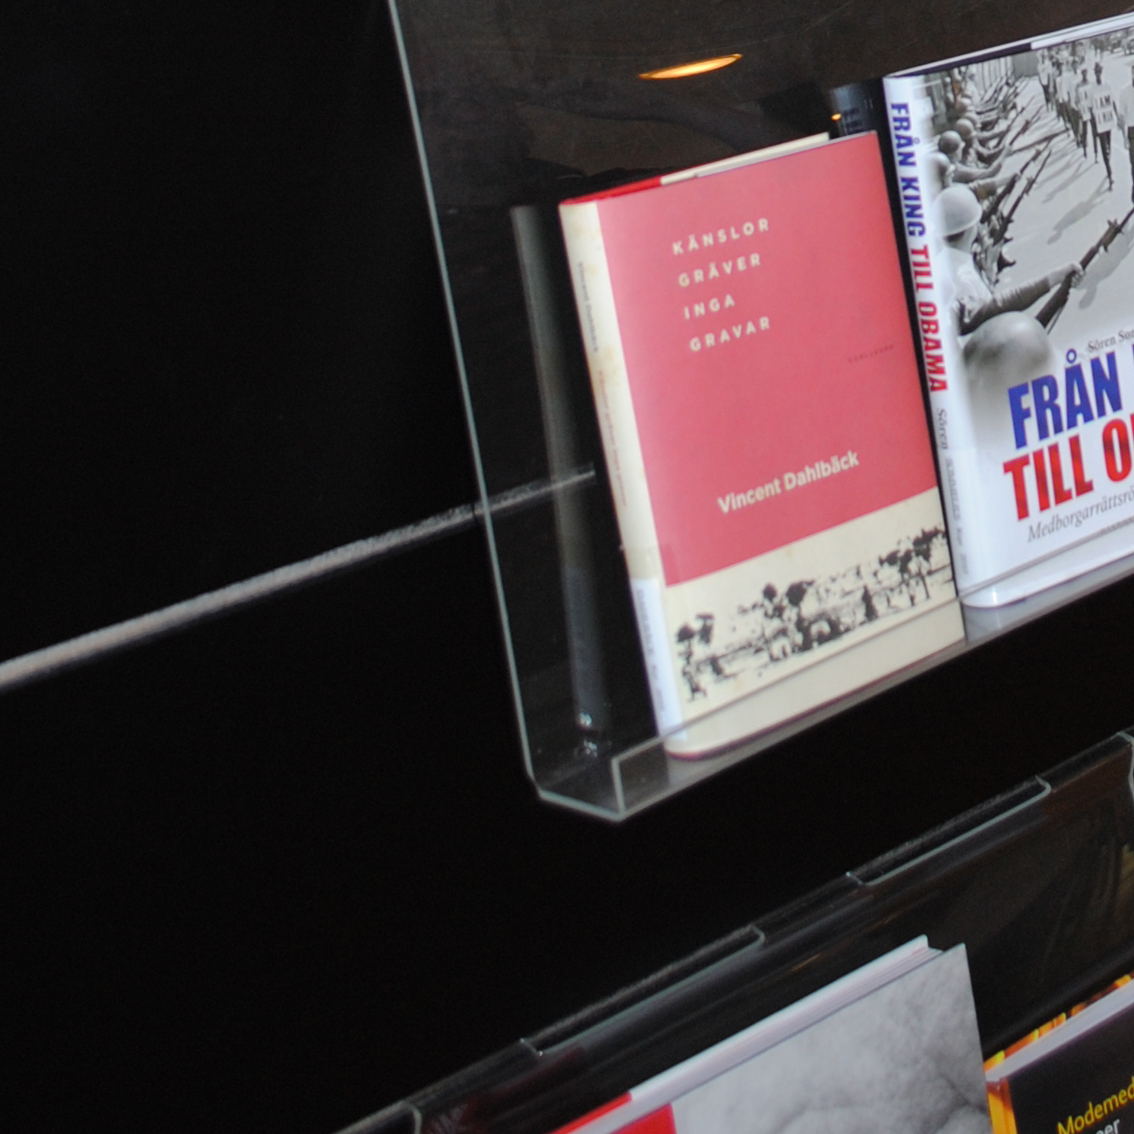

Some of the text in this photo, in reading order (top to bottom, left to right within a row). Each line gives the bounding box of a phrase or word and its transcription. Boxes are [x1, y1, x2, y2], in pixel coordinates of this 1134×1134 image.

[673, 217, 770, 255] KÄNSLOR
[678, 252, 763, 288] GRÄVER
[891, 102, 949, 450] FRÅN KING TILL OBAMA Sören
[683, 294, 736, 320] INGA
[690, 316, 771, 351] GRAVAR
[1087, 331, 1116, 354] Sören
[1007, 348, 1123, 449] FRÅN
[718, 449, 859, 515] Vincent Dahlbäck
[1003, 435, 1094, 521] TILL
